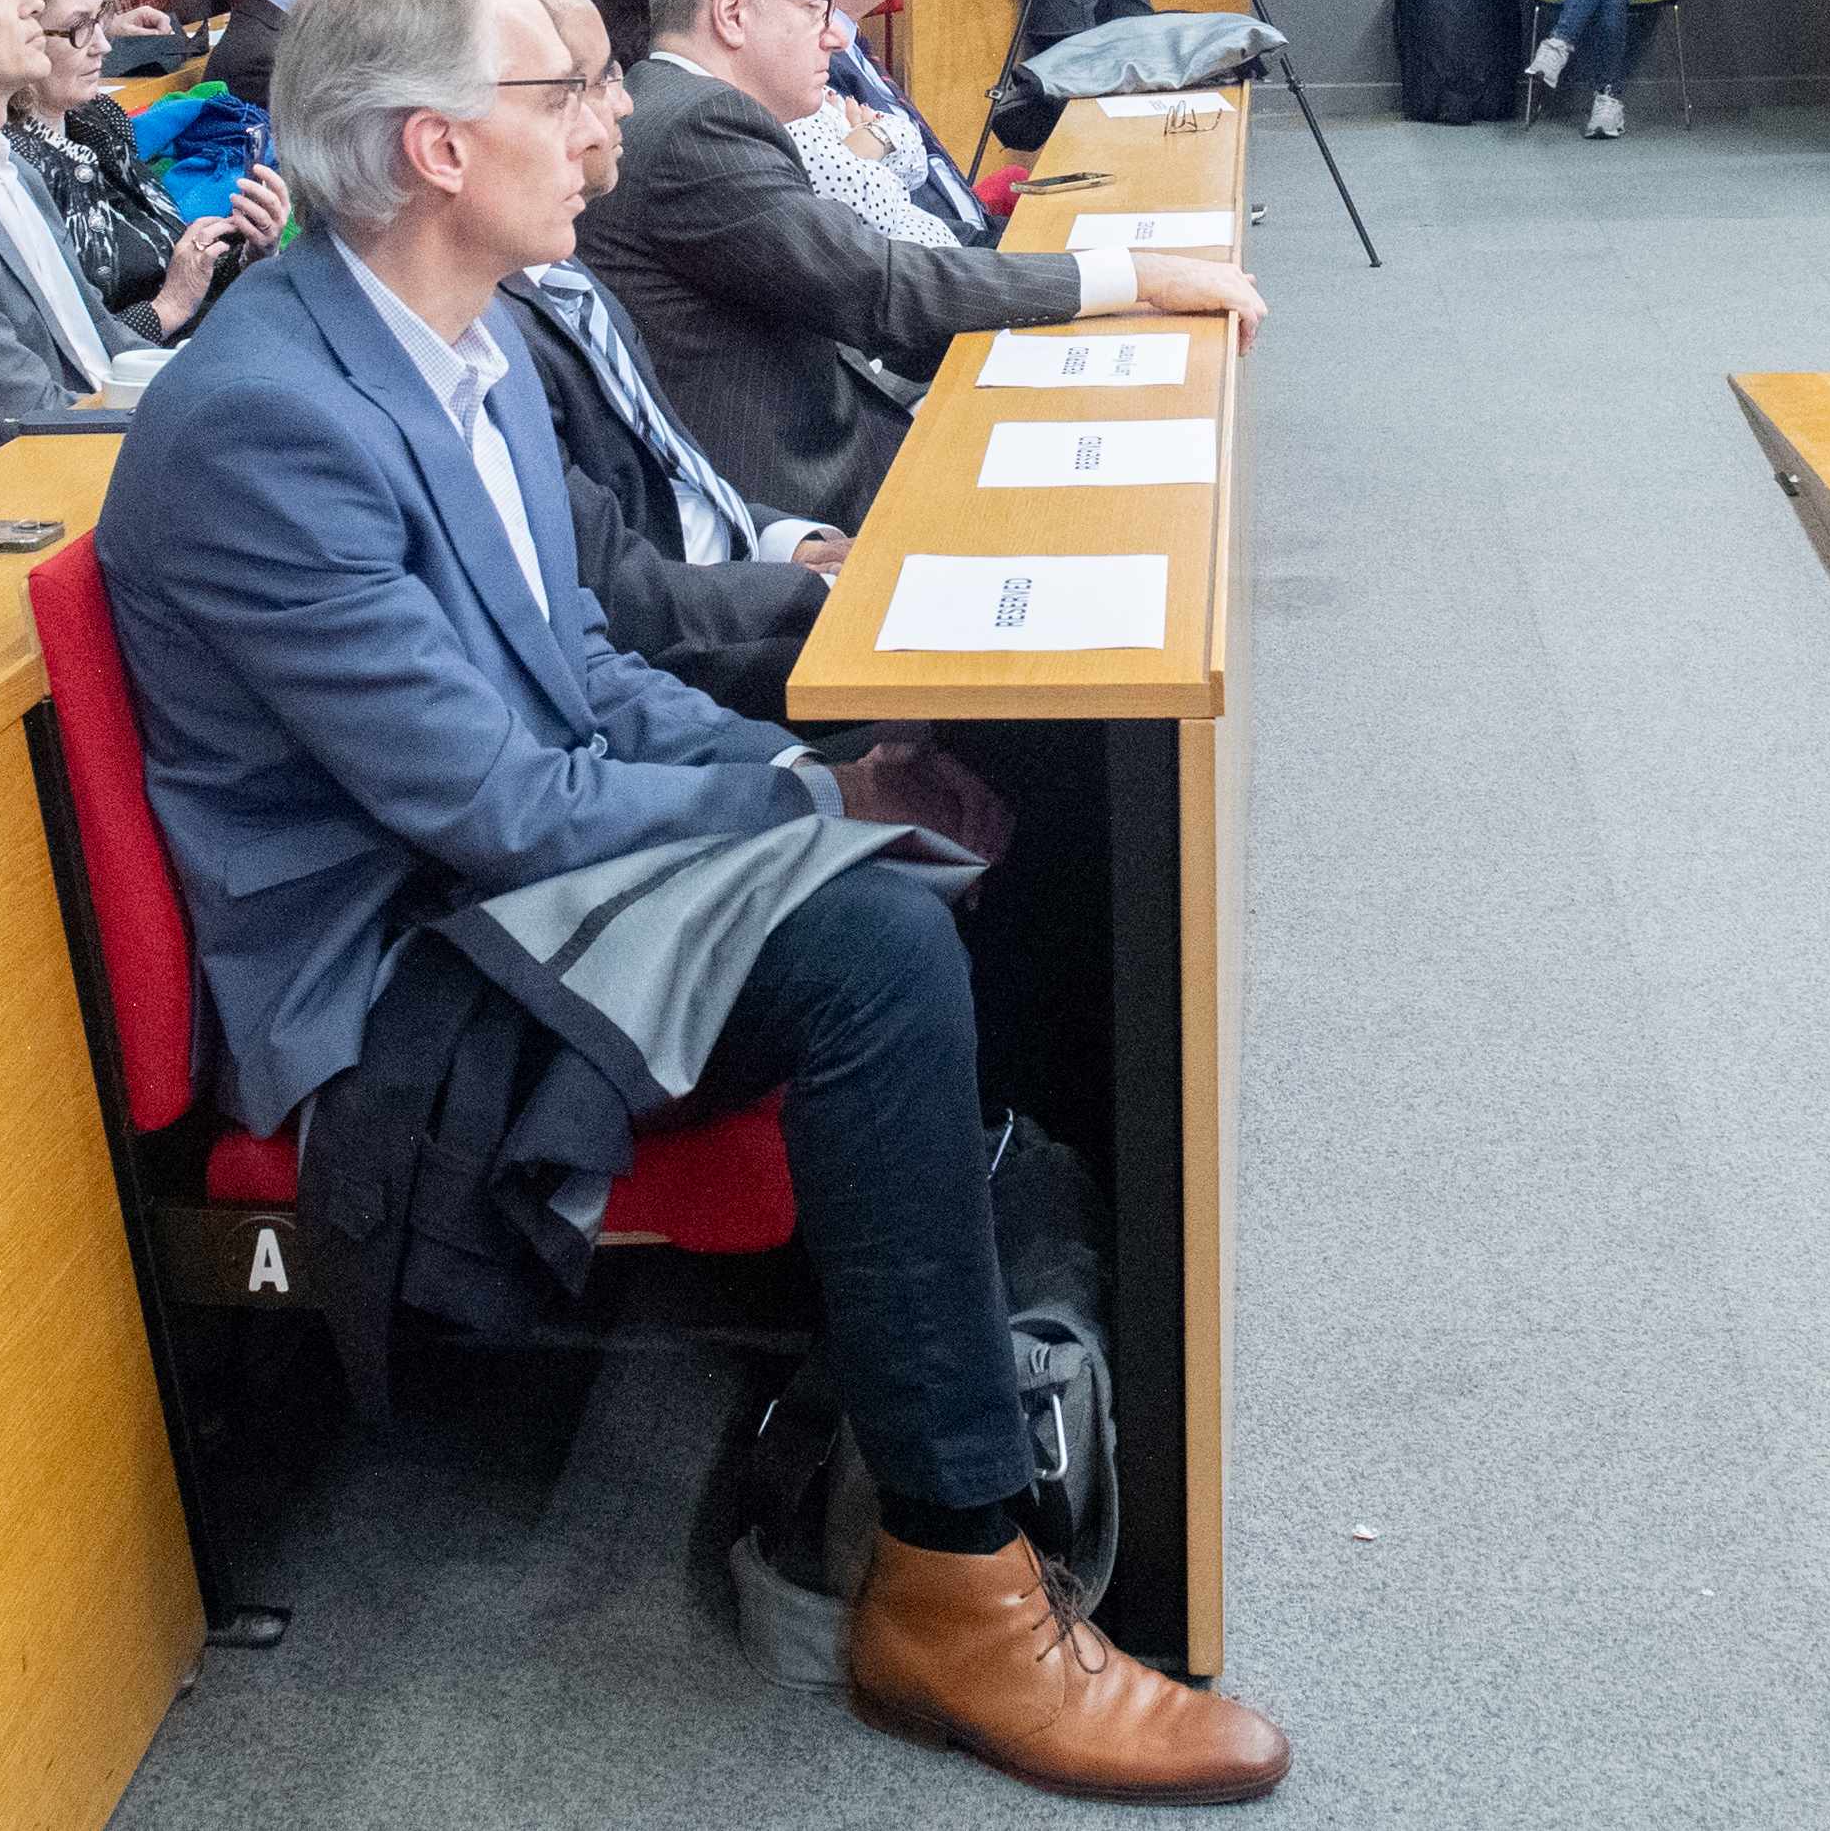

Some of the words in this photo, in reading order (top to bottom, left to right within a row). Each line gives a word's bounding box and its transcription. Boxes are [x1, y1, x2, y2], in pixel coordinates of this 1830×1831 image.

[1061, 346, 1090, 376] RESERVED
[1074, 435, 1103, 471] RESERVED
[994, 577, 1033, 627] RESERVED
[248, 1228, 289, 1292] A
